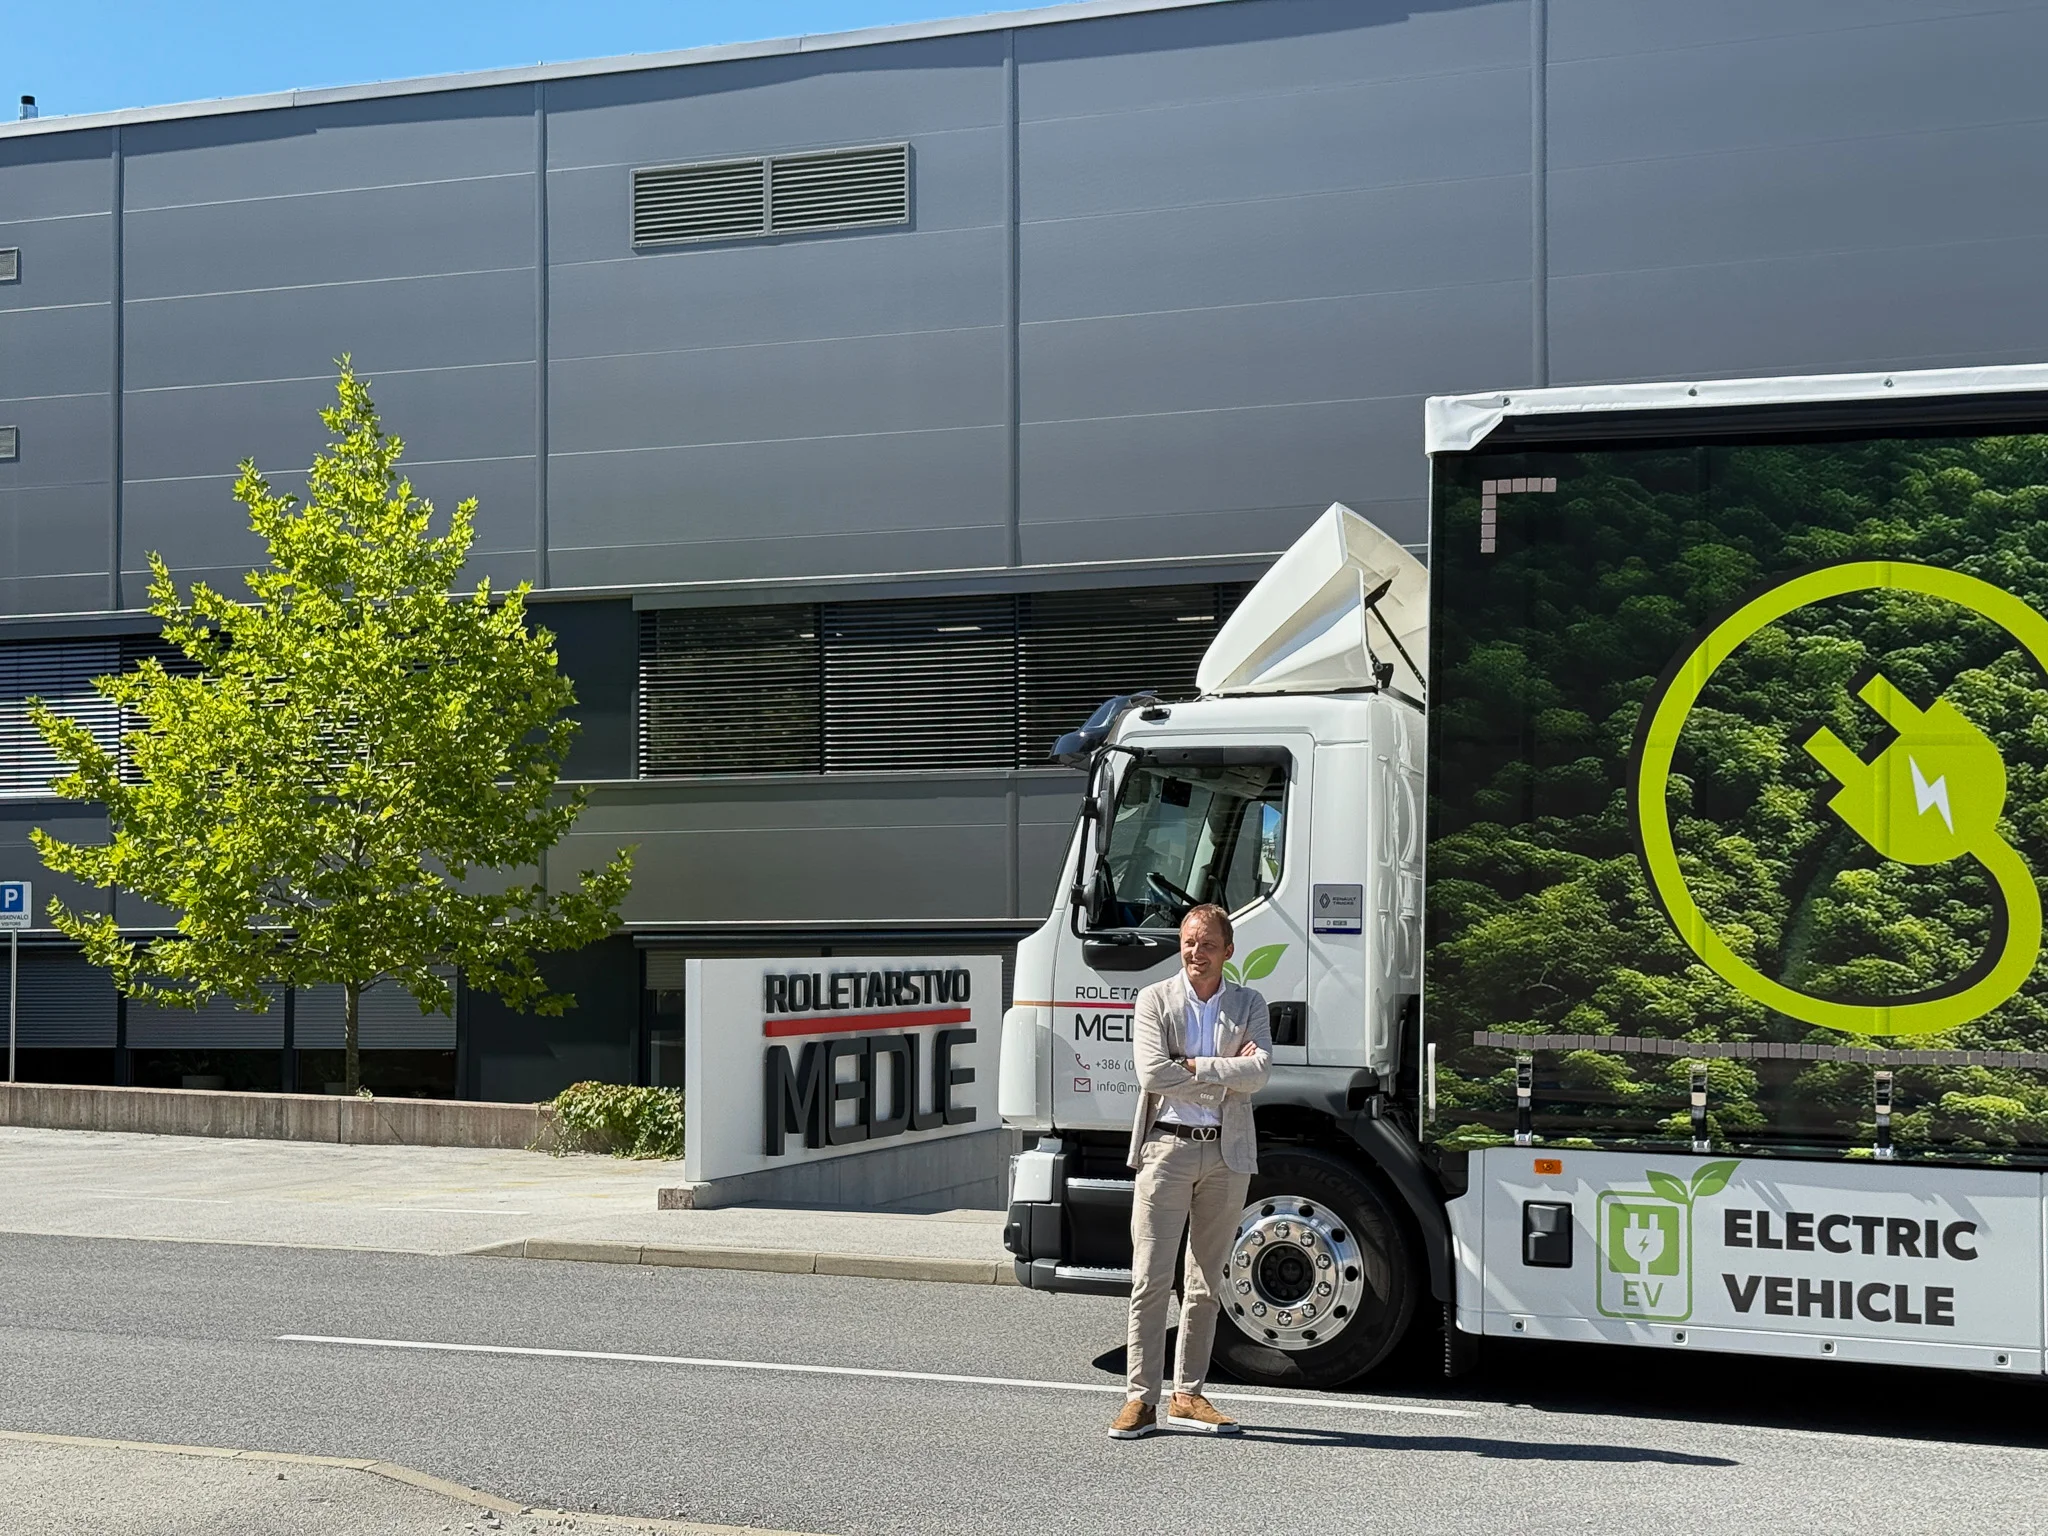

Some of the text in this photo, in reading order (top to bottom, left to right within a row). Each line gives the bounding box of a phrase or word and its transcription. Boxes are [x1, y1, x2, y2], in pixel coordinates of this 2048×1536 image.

[5, 888, 19, 909] P
[765, 968, 971, 1014] ROLETARSTVO
[1096, 1059, 1121, 1070] +386
[765, 1028, 977, 1157] MEDLE
[1723, 1208, 1979, 1261] ELECTRIC
[1623, 1280, 1664, 1307] EV
[1721, 1273, 1956, 1327] VEHICLE
